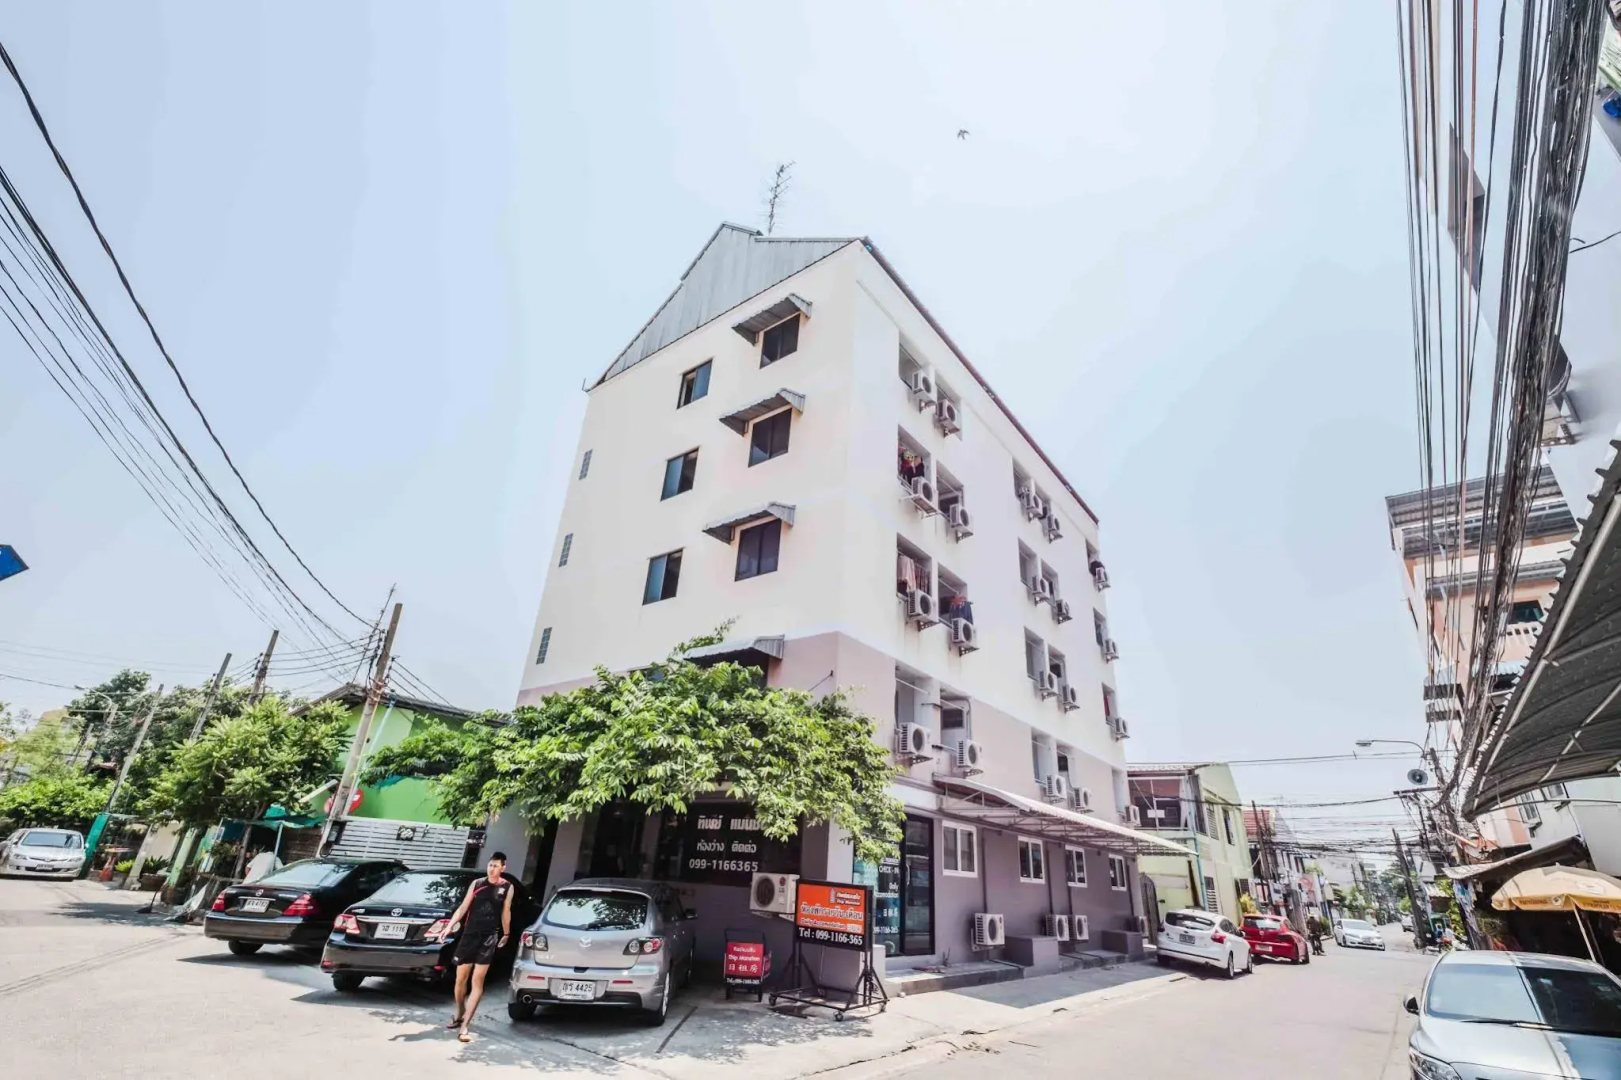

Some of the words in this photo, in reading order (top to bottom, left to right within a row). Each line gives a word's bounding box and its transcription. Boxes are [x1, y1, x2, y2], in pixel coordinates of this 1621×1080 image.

[696, 839, 725, 852] ห้องว่าง
[731, 840, 757, 853] ติดต่อ
[688, 859, 759, 872] 099-1166365
[816, 930, 863, 945] 099-1166-365
[575, 983, 593, 993] 4425
